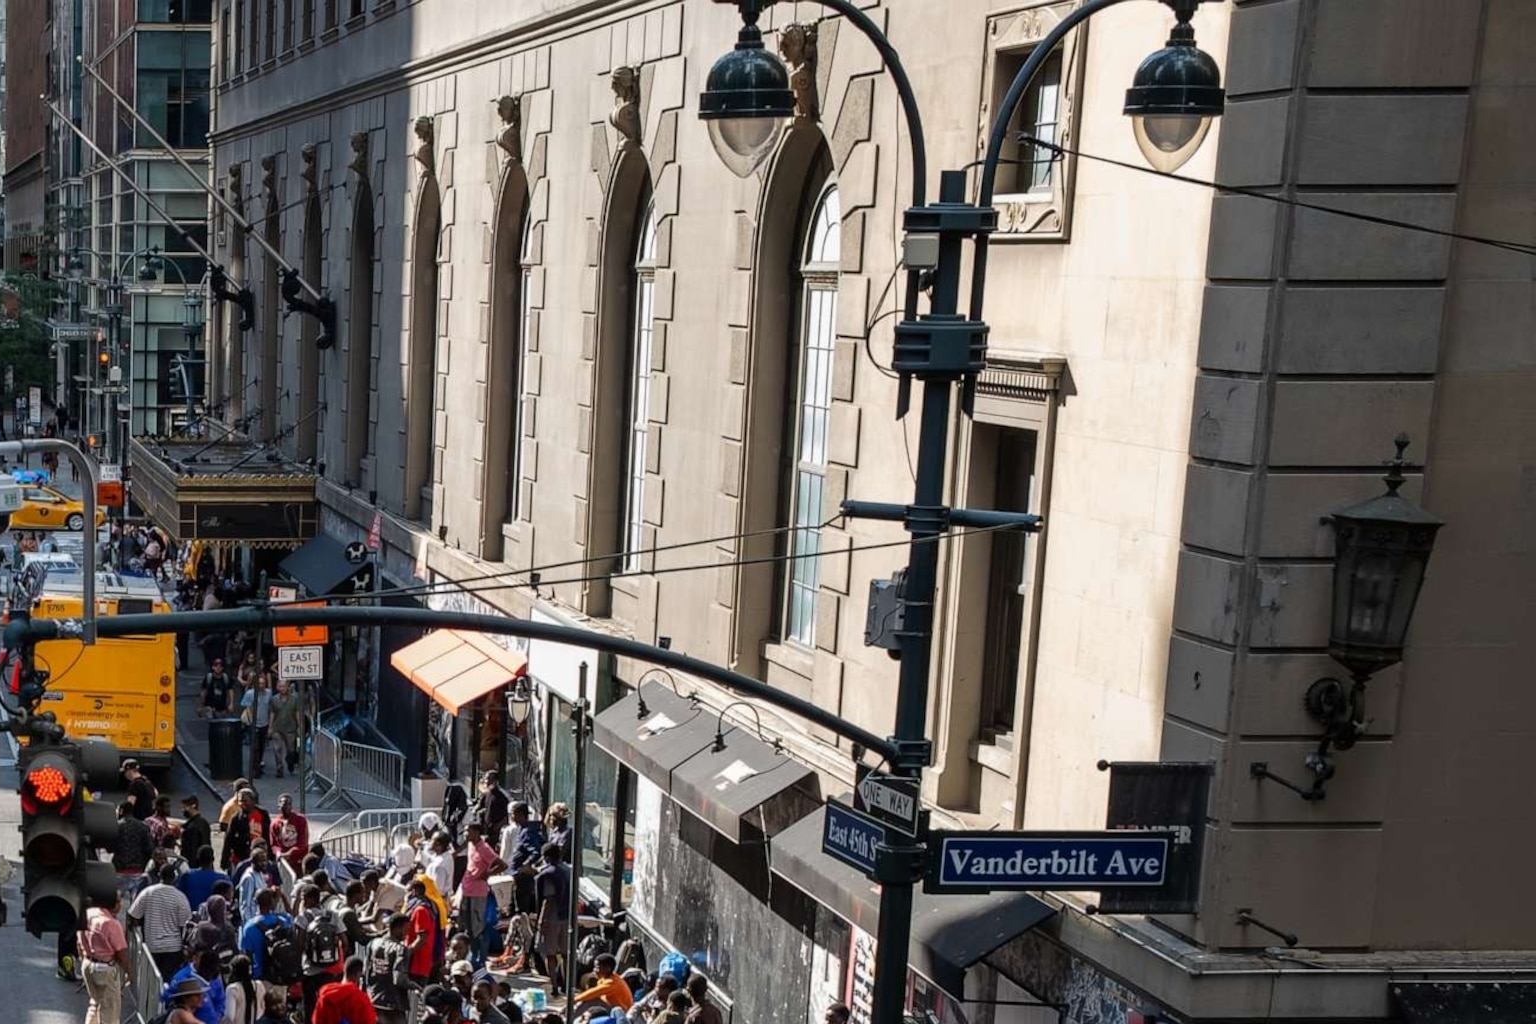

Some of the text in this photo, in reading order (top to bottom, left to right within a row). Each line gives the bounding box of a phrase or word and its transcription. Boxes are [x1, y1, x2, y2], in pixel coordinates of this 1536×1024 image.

[284, 664, 318, 674] 47th ST
[289, 652, 312, 662] EAST
[863, 781, 910, 816] ONE WAY
[828, 815, 848, 847] East
[848, 827, 868, 858] 45th
[948, 848, 1160, 876] Vanderbilt Ave
